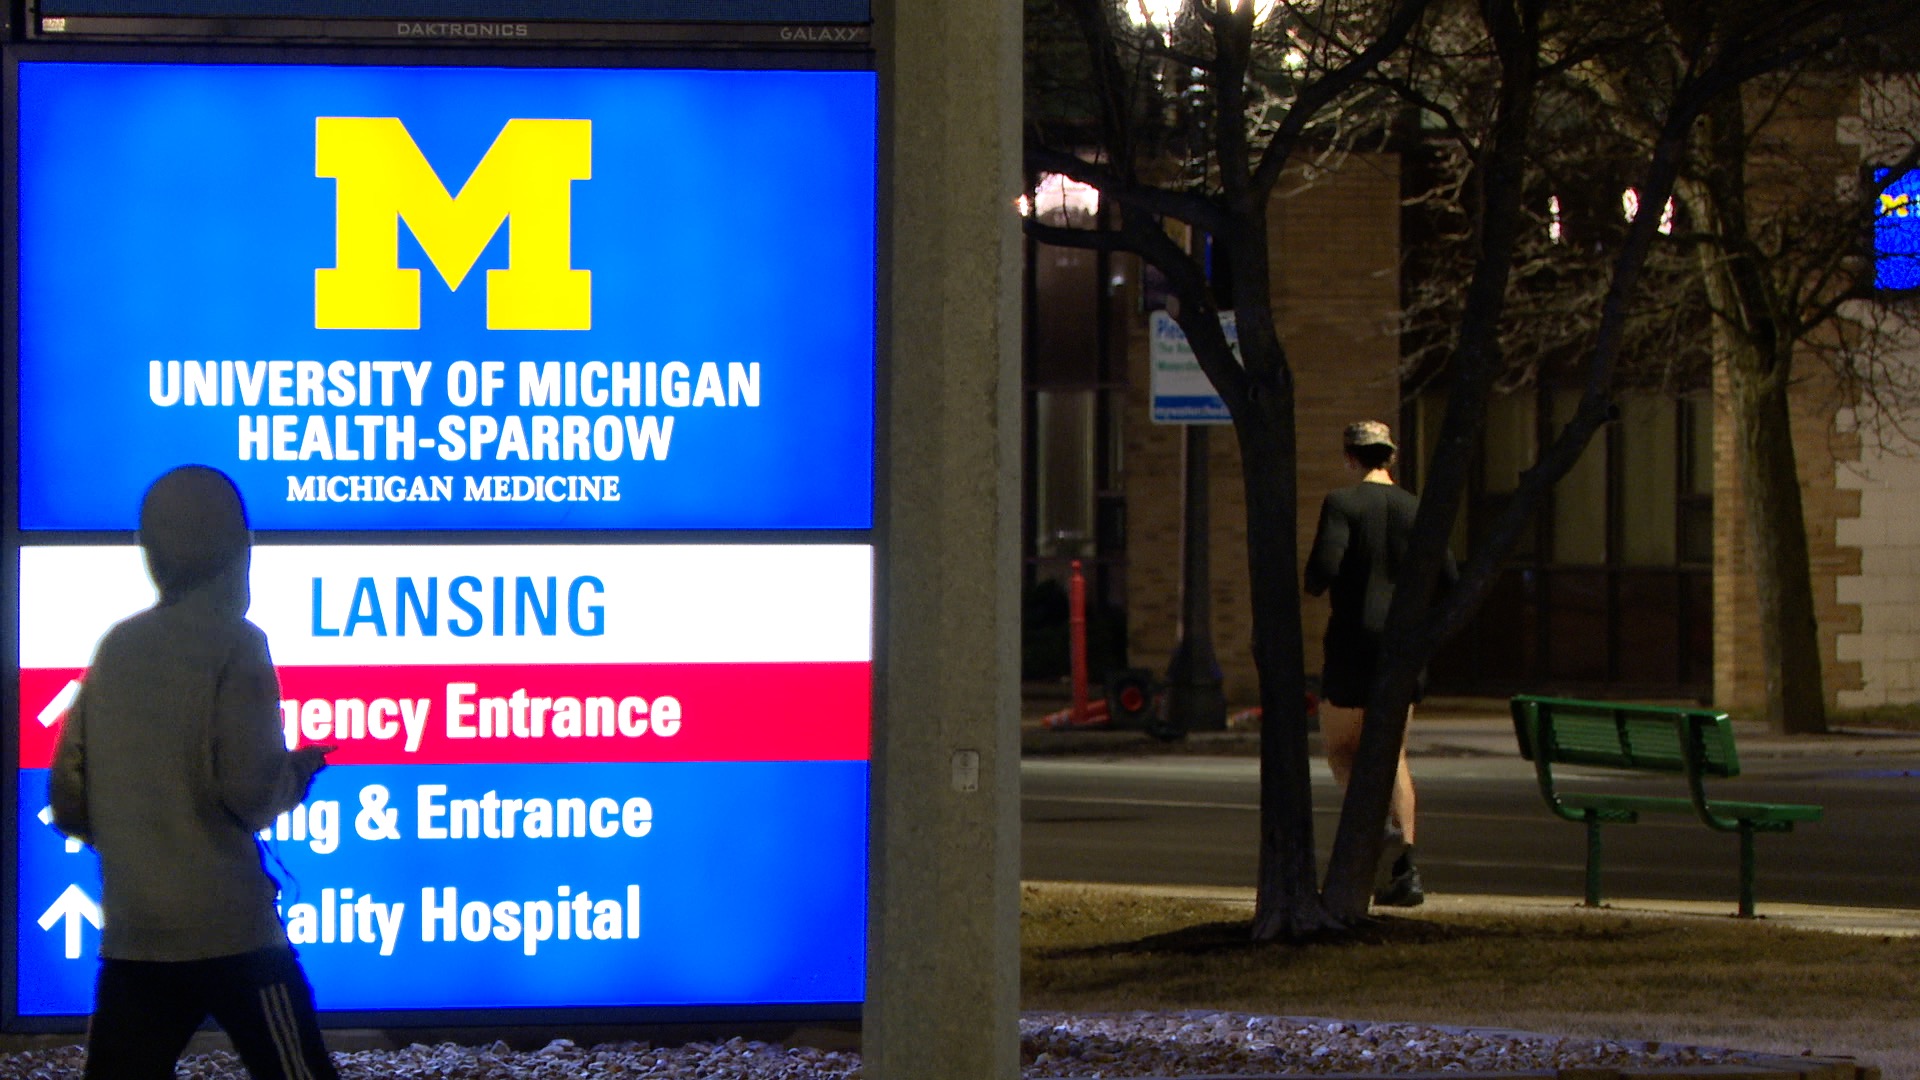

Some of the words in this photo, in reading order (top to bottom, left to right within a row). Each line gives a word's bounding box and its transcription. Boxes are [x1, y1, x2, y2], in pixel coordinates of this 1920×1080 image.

[397, 23, 528, 36] DAKTRONICS
[780, 27, 860, 41] GALAXY
[315, 116, 592, 331] M
[149, 360, 433, 407] UNIVERSITY
[447, 361, 505, 407] OF
[519, 361, 760, 408] MICHIGAN
[238, 414, 675, 462] HEALTH-SPARROW
[286, 475, 454, 503] MICHIGAN
[463, 475, 621, 503] MEDICINE
[312, 576, 605, 637] LANSING
[280, 698, 430, 752] gency
[446, 682, 682, 739] Entrance
[354, 784, 401, 840] &
[417, 784, 654, 840] Entrance
[421, 885, 641, 956] Hospital
